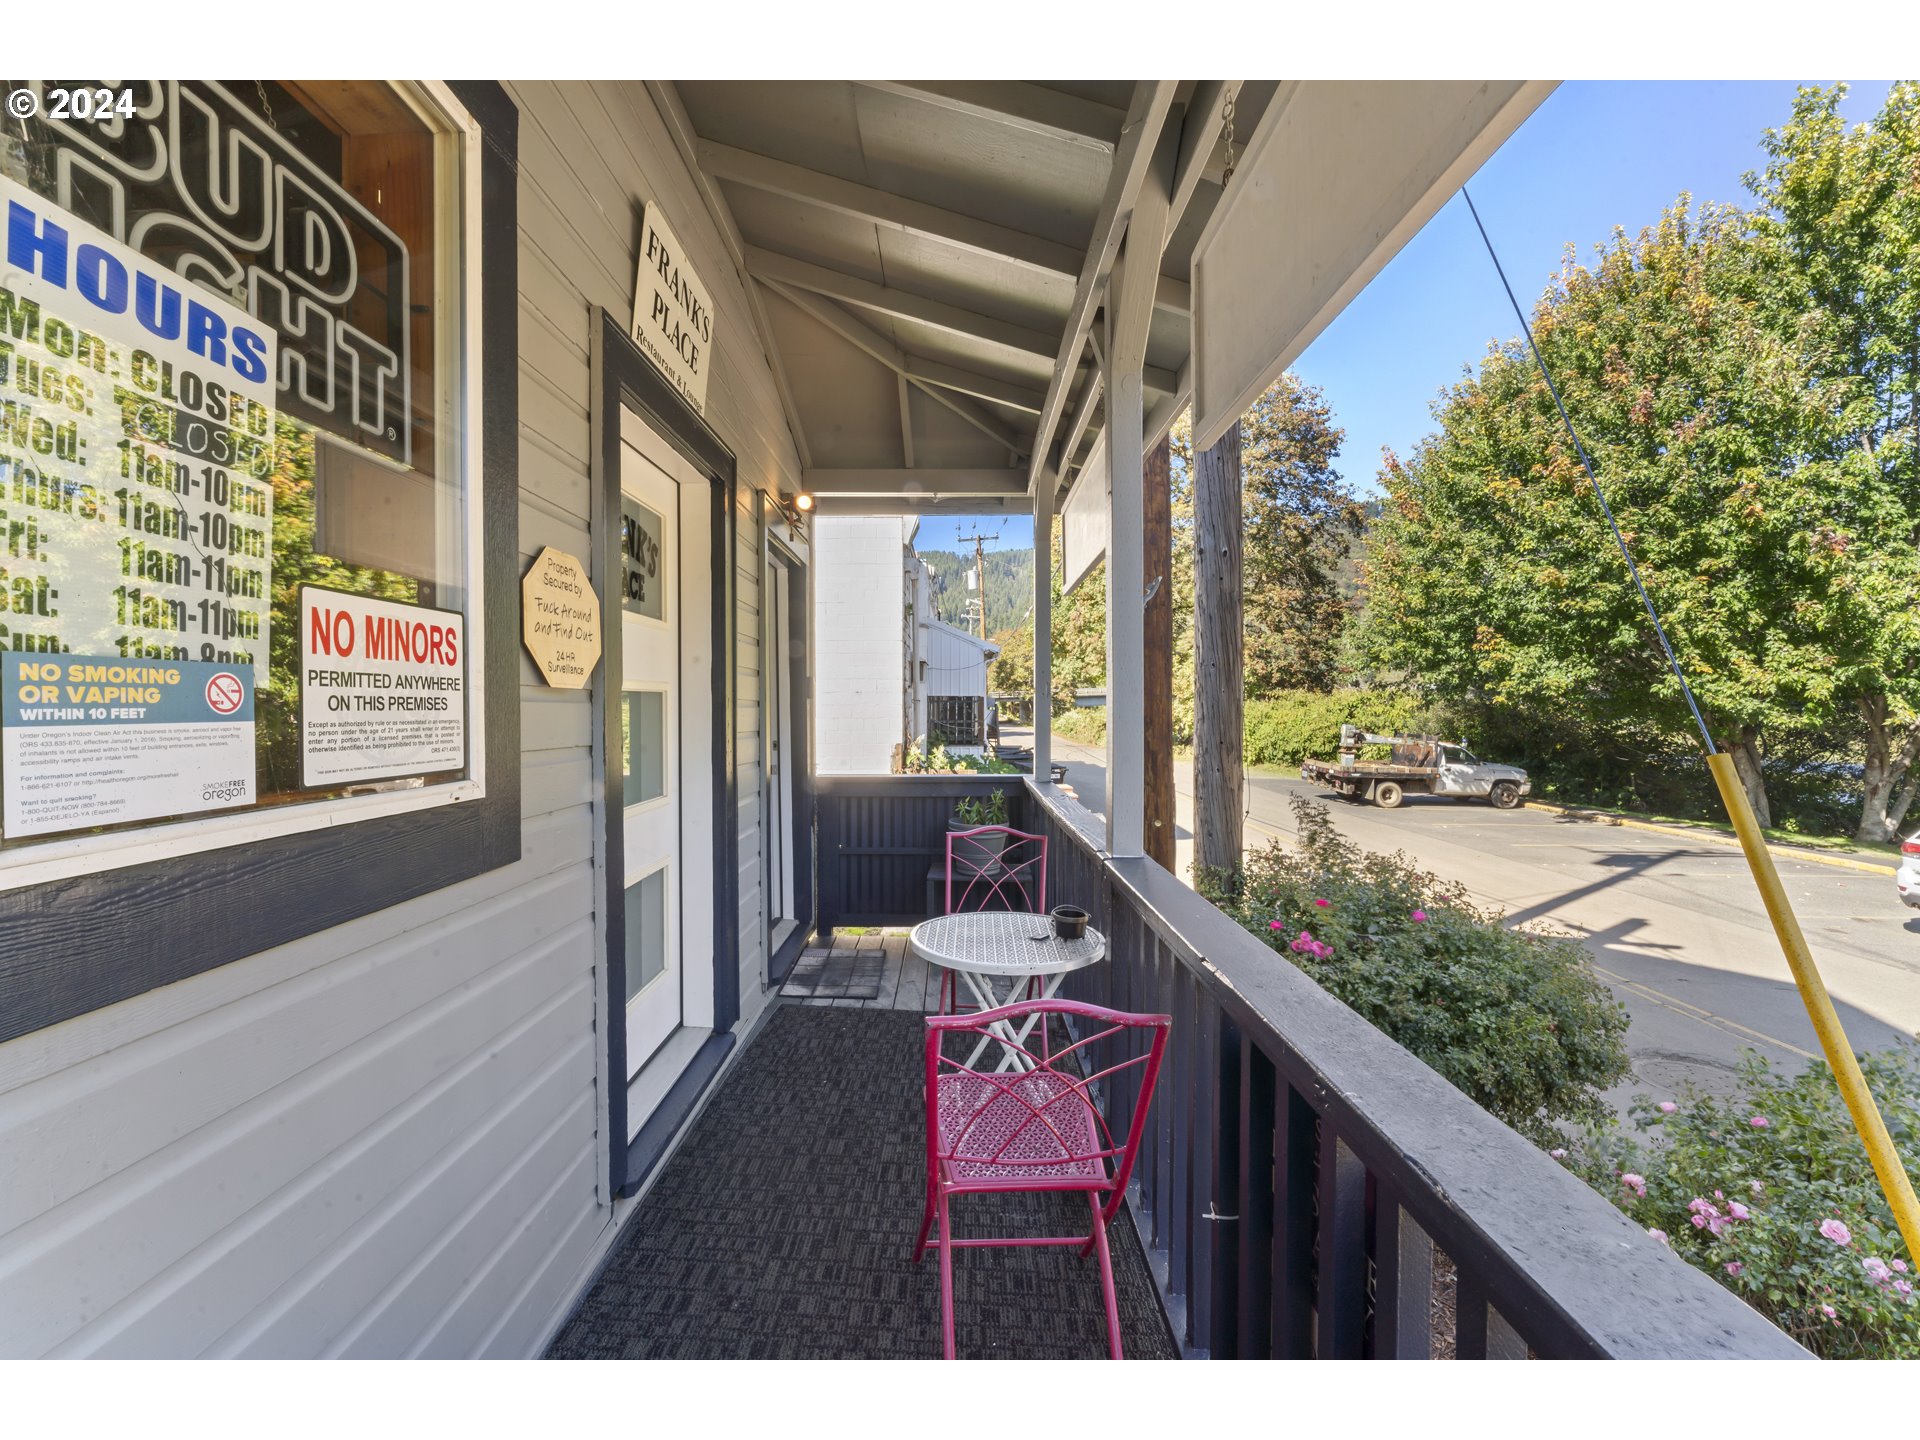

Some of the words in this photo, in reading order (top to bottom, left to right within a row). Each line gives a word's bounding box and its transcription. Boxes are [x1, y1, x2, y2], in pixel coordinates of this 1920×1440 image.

[7, 199, 268, 384] HOURS
[646, 225, 710, 343] FRANK'S
[651, 287, 699, 375] PLACE
[0, 287, 119, 378] Mon:
[131, 349, 268, 437] CLOSED
[636, 324, 676, 381] Restaurant
[677, 374, 682, 387] &
[682, 381, 703, 414] Lounge
[135, 403, 269, 475] CLOSED
[117, 438, 265, 518] 11am-10pm
[114, 487, 264, 558] 11am-10pm
[619, 513, 659, 578] NK'S
[117, 536, 263, 599] 11am-11pm
[547, 557, 577, 581] Property
[543, 572, 573, 593] Secured
[574, 584, 583, 598] by
[112, 585, 259, 640] 11am-11pm
[534, 597, 559, 616] Fuck
[561, 604, 592, 623] Around
[311, 606, 355, 658] NO
[365, 615, 457, 666] MINORS
[534, 619, 552, 635] and
[553, 622, 573, 639] Find
[576, 626, 593, 642] Out
[115, 636, 254, 665] 11m8m
[556, 650, 565, 661] 24
[566, 652, 576, 662] HR
[19, 663, 61, 682] NO
[68, 664, 181, 684] SMOKING
[308, 669, 392, 689] PERMITTED
[395, 674, 461, 691] ANYWHERE
[547, 661, 584, 676] Surveillance
[18, 685, 60, 704] OR
[66, 686, 161, 704] VAPING
[328, 694, 350, 711] ON
[354, 696, 385, 711] THIS
[388, 696, 448, 711] PREMISES
[19, 708, 84, 721] WITHIN
[89, 708, 107, 719] 10
[111, 707, 146, 719] FEET
[308, 721, 328, 729] Except
[42, 731, 71, 739] Oregon's
[388, 741, 411, 749] prohibited
[203, 779, 245, 790] SMOKEFREE
[203, 787, 246, 802] oregon
[64, 793, 97, 802] smoking?
[21, 805, 79, 815] 1-800-QUIT-NOW
